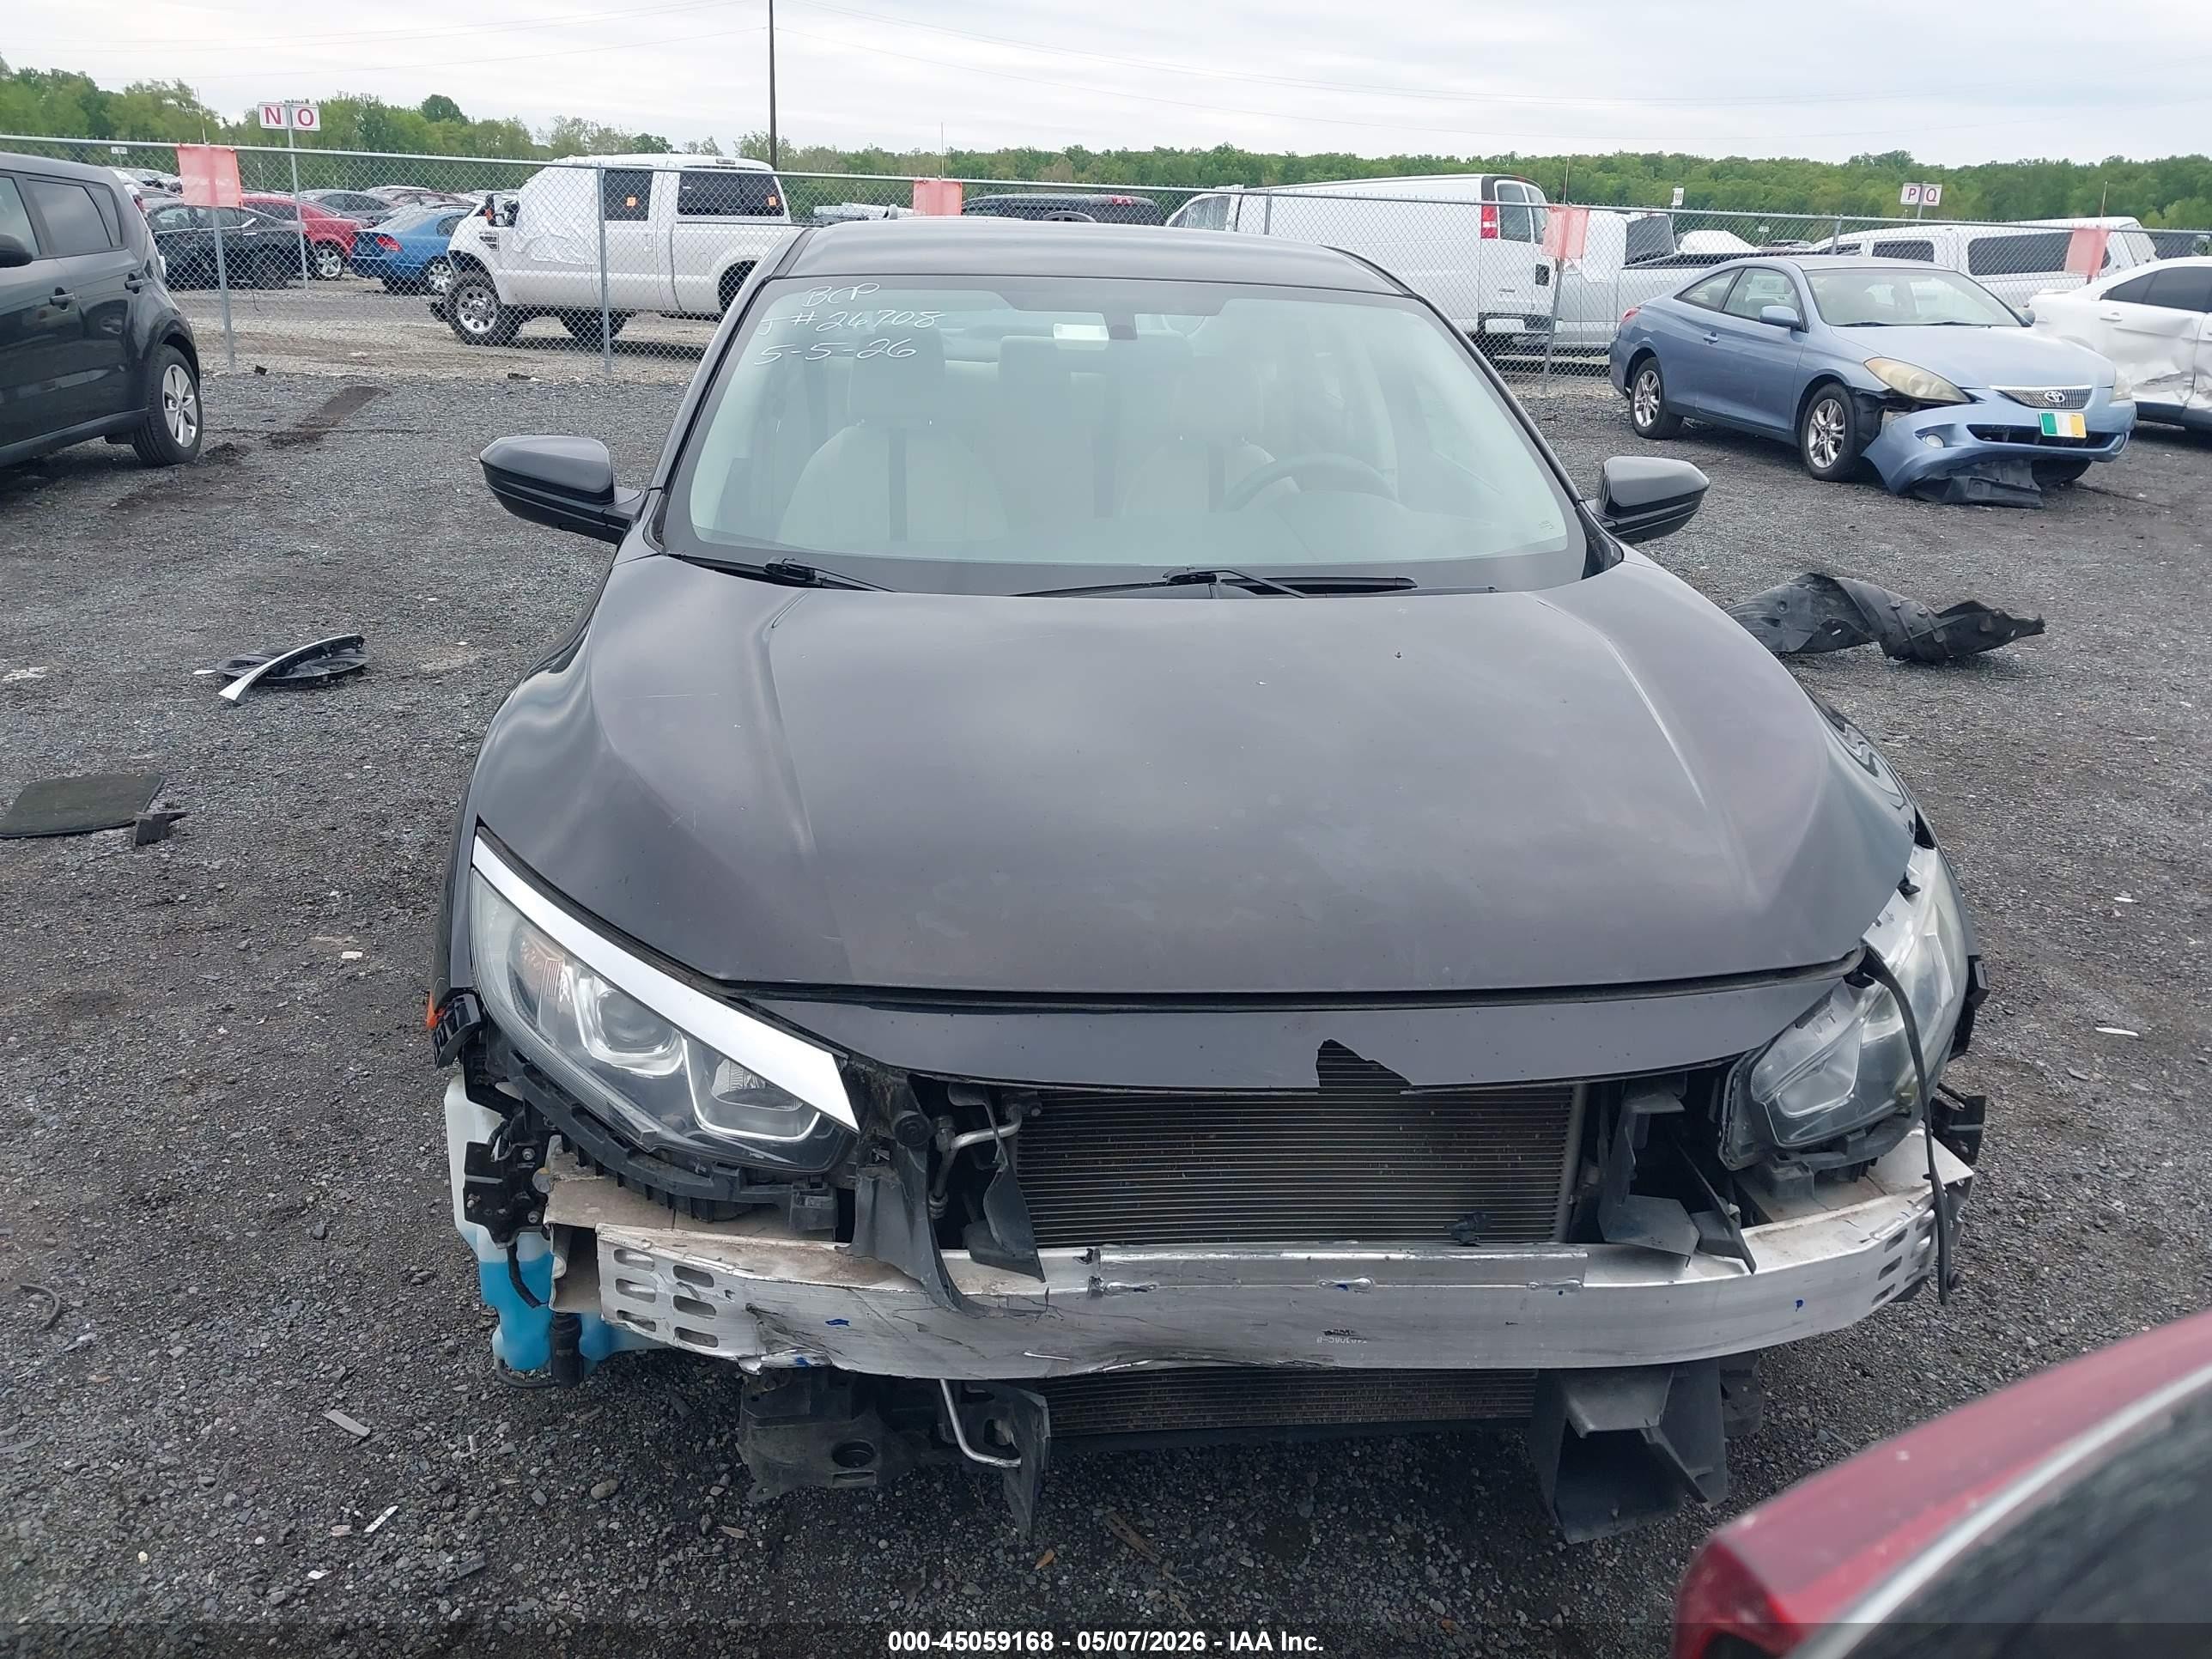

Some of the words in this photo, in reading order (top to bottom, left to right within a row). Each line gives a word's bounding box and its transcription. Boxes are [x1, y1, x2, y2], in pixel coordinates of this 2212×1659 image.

[264, 106, 282, 125] N
[297, 108, 314, 126] O
[1907, 187, 1917, 200] P
[1926, 188, 1936, 202] Q
[754, 337, 917, 365] 5-5-26
